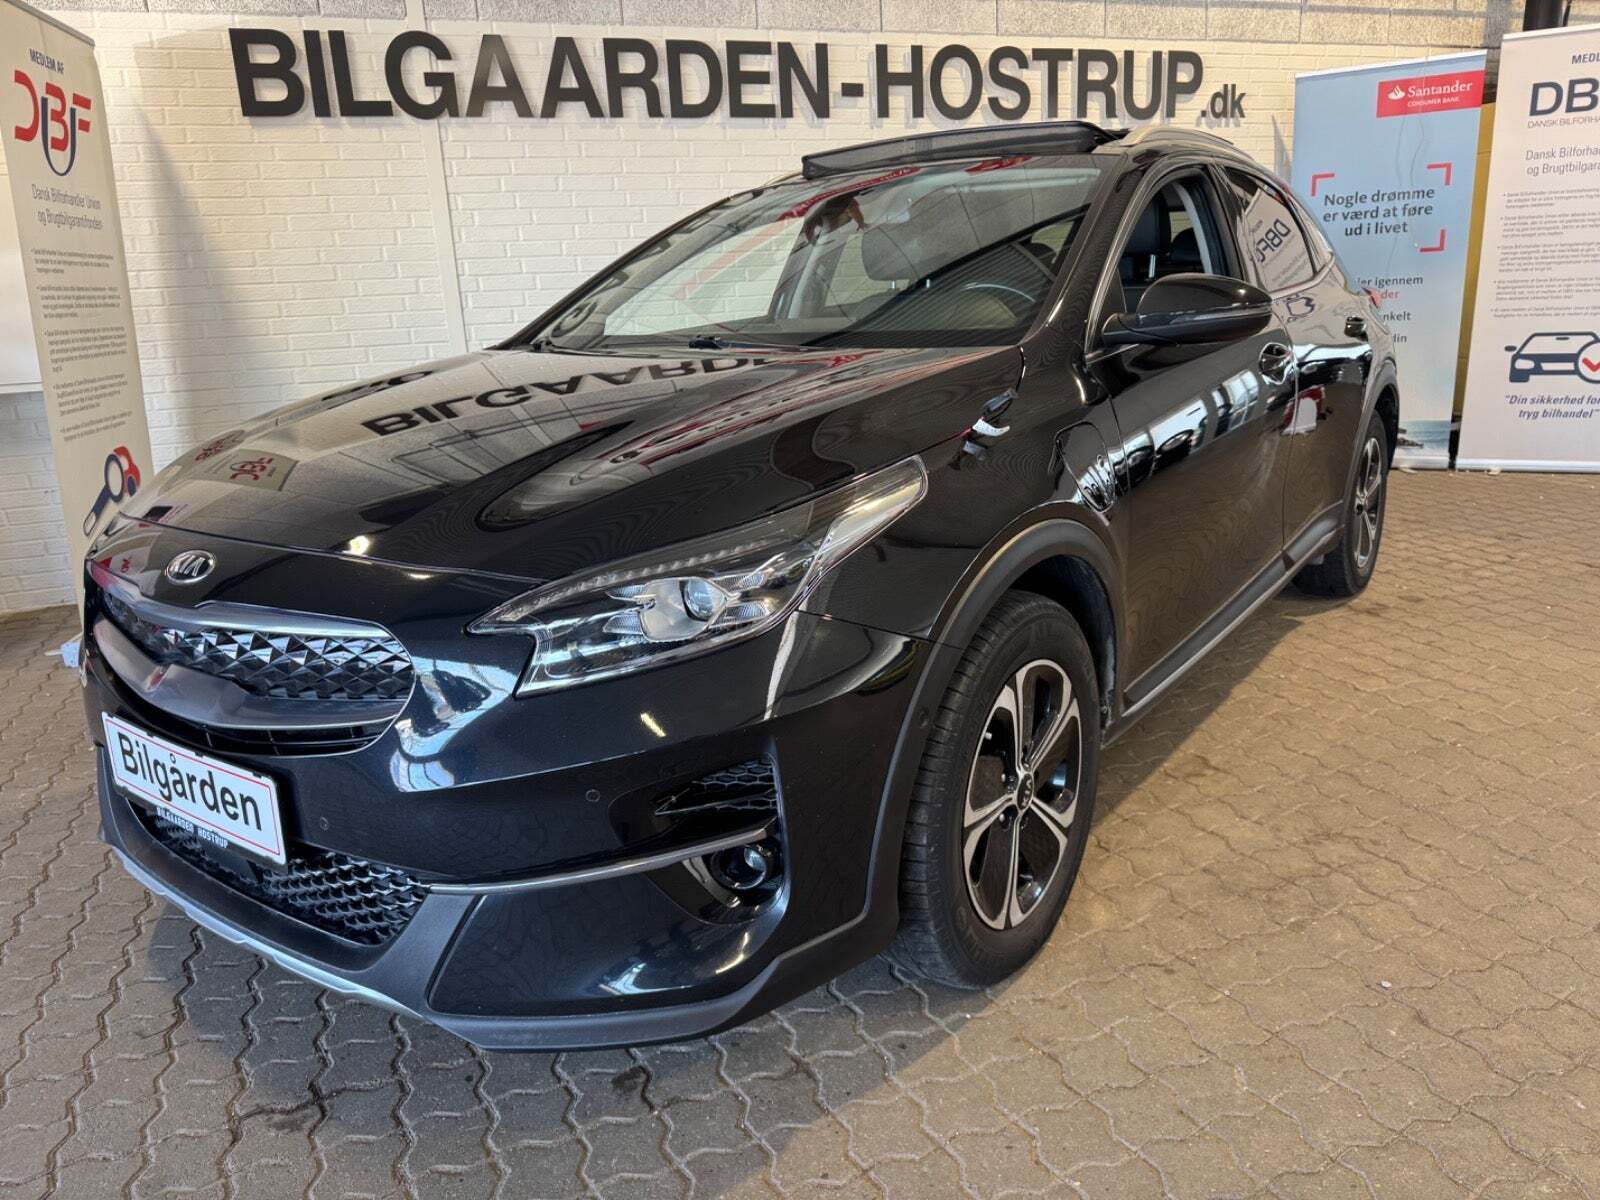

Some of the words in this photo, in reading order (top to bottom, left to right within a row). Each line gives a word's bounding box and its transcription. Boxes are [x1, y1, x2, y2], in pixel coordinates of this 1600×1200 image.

[1407, 80, 1473, 98] Santander
[1408, 98, 1441, 107] CONSUMER
[1442, 97, 1460, 105] BANK
[1527, 119, 1557, 129] DANSK
[1526, 148, 1556, 160] Dansk
[1526, 167, 1539, 177] og
[1324, 192, 1367, 208] Nogle
[1371, 189, 1435, 203] drømme
[1323, 213, 1338, 222] er
[1342, 206, 1379, 221] værd
[1383, 206, 1398, 218] at
[1402, 204, 1433, 217] føre
[1345, 223, 1362, 236] ud
[1367, 223, 1371, 235] i
[1375, 222, 1408, 234] livet
[1375, 276, 1424, 289] igennem
[1383, 311, 1411, 321] nkelt
[1529, 394, 1585, 405] sikkerhed
[1518, 410, 1540, 420] tryg
[118, 731, 261, 831] Bilgården
